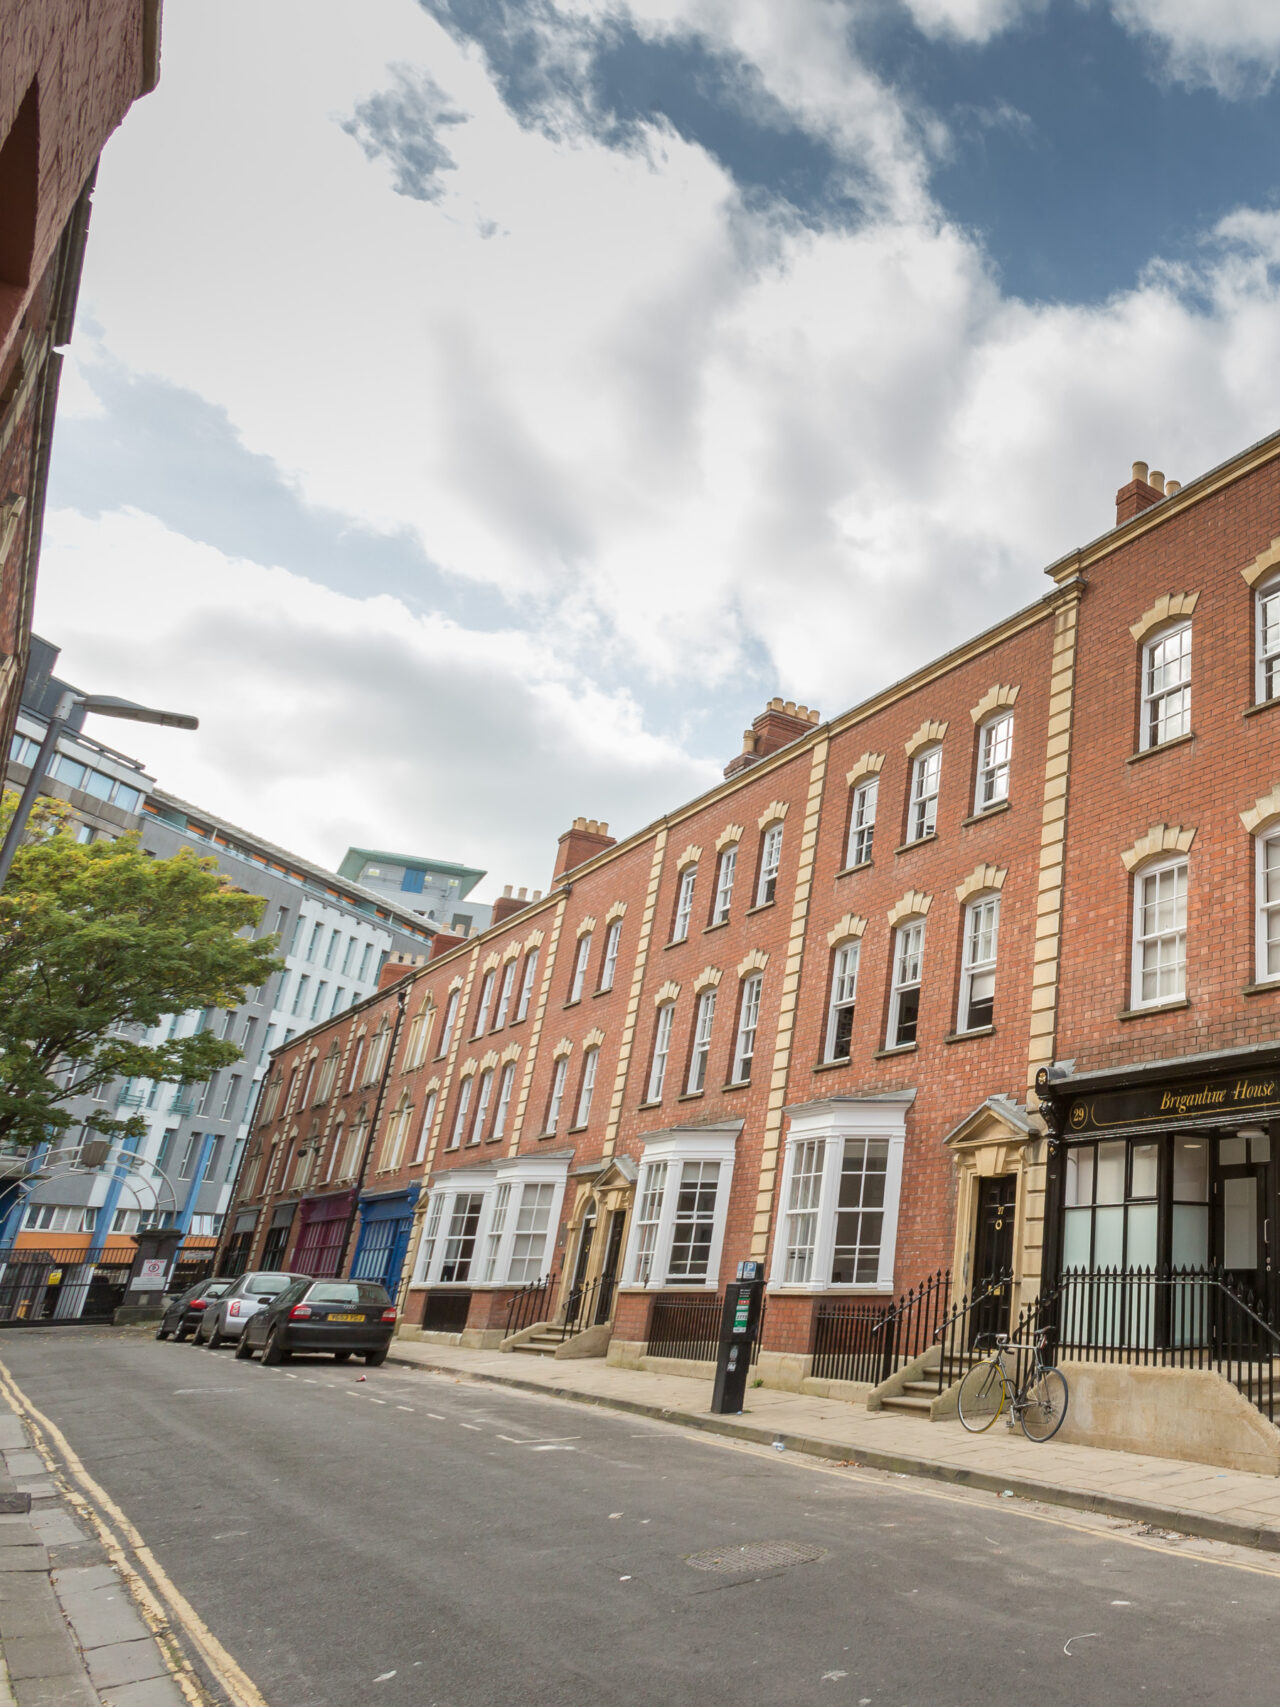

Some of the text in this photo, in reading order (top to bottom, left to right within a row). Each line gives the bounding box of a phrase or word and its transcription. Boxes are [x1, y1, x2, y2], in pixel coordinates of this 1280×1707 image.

[1160, 1080, 1275, 1114] Brigantine House
[1073, 1107, 1084, 1121] 29
